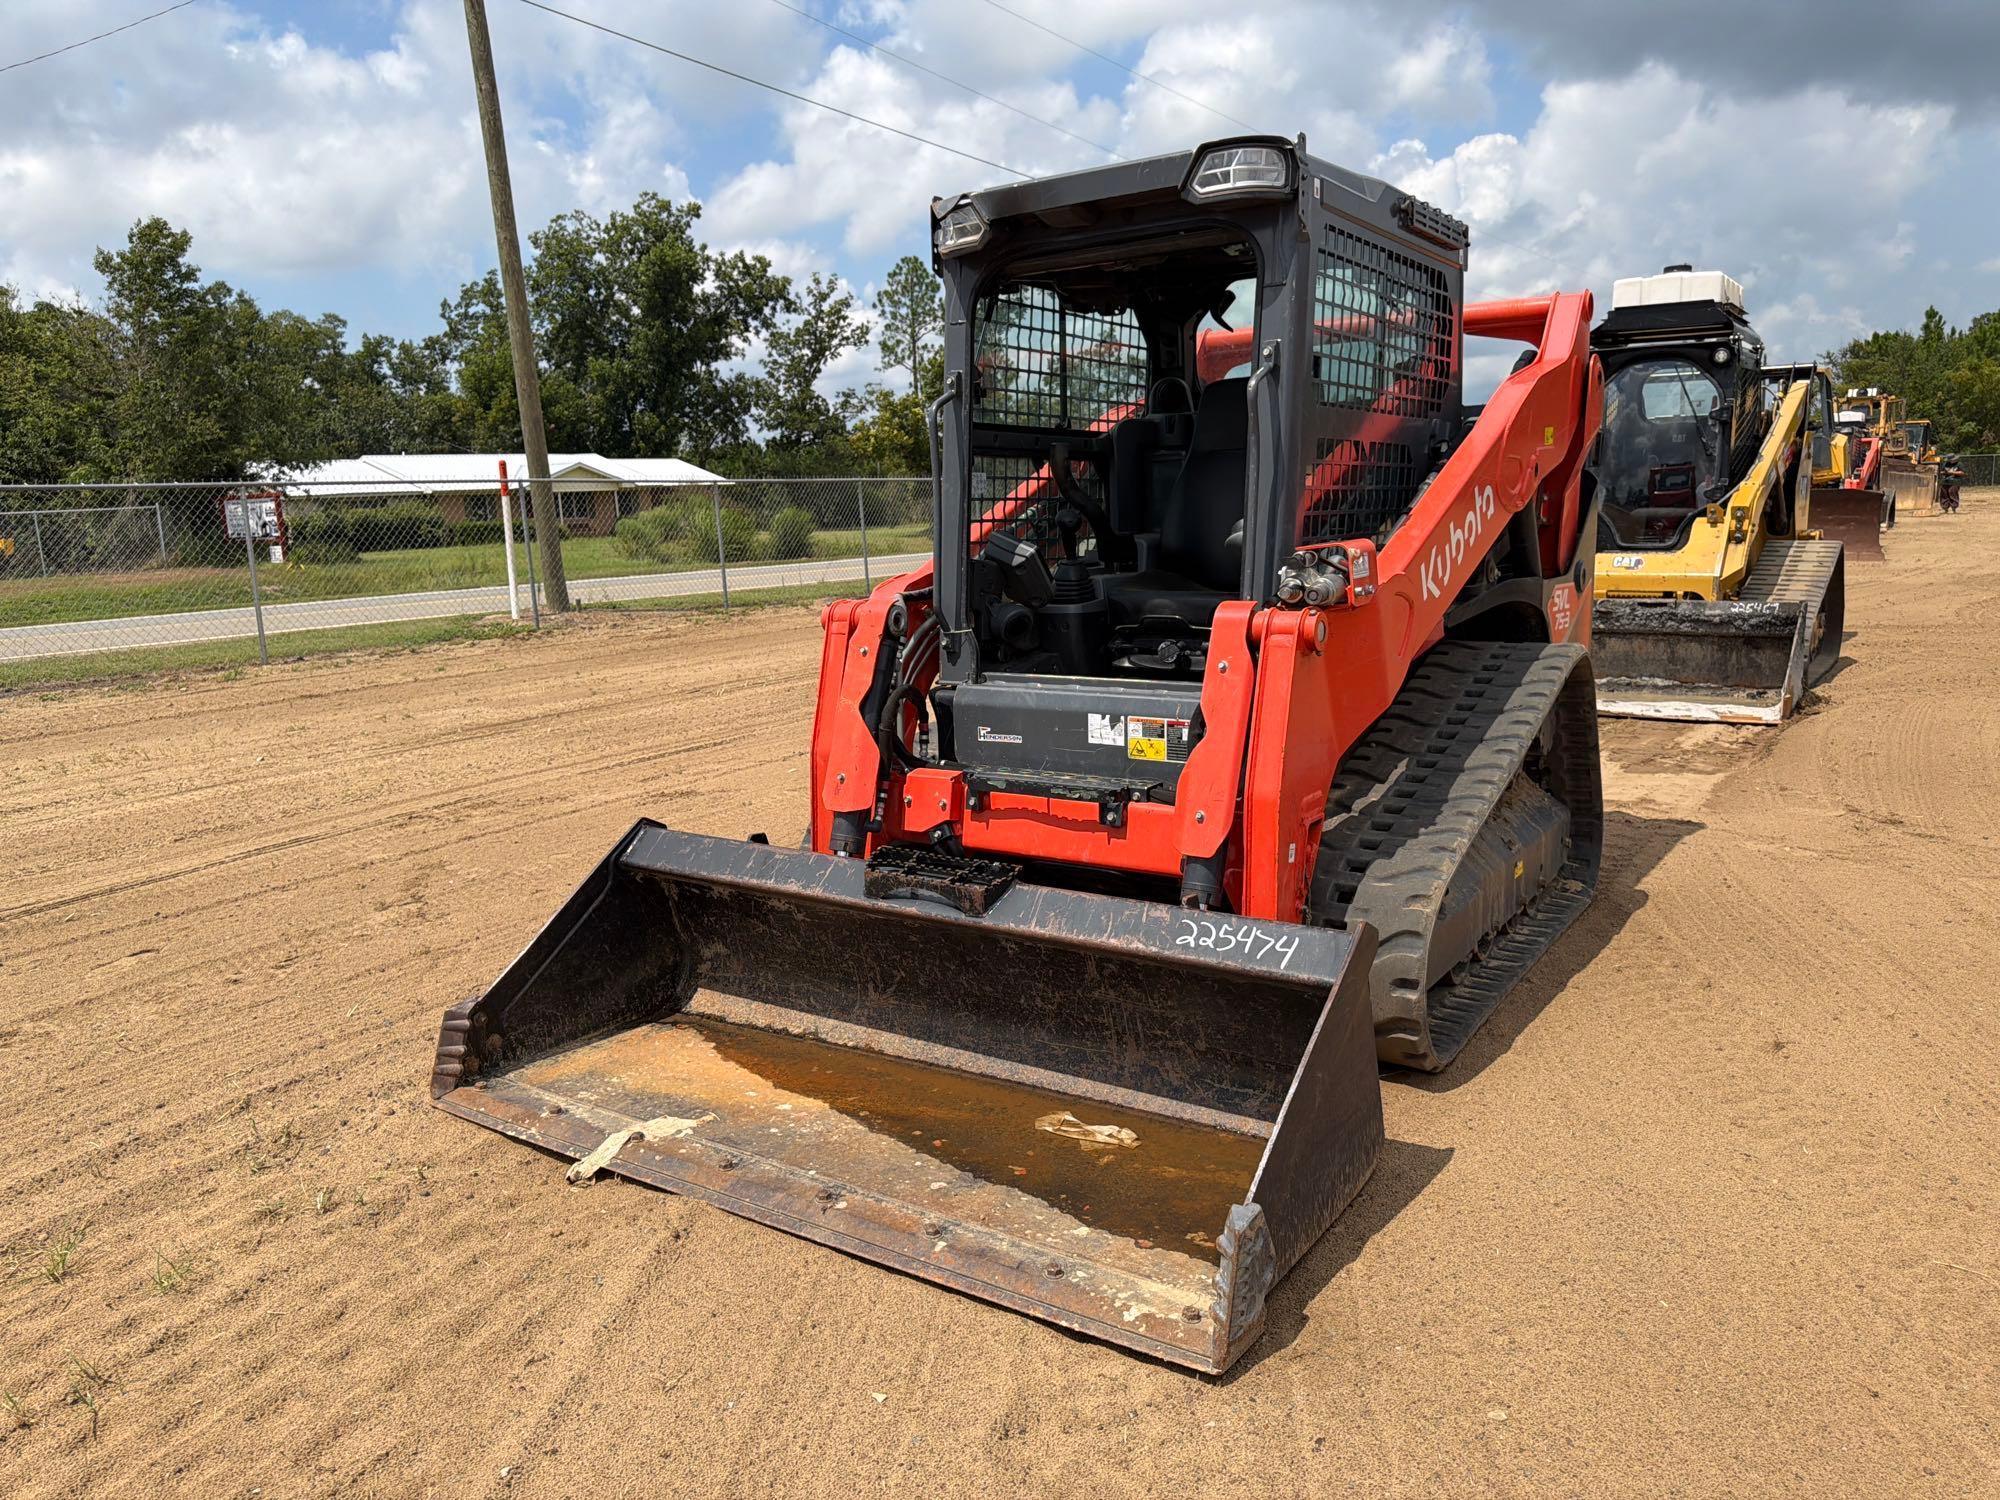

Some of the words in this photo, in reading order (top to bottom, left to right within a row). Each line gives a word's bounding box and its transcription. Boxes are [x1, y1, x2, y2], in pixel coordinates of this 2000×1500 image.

[1420, 485, 1494, 601] Kubota
[1613, 556, 1637, 568] CAT
[1552, 588, 1570, 612] SVL
[978, 727, 1022, 743] HENDERSON
[1175, 919, 1300, 970] 225474
